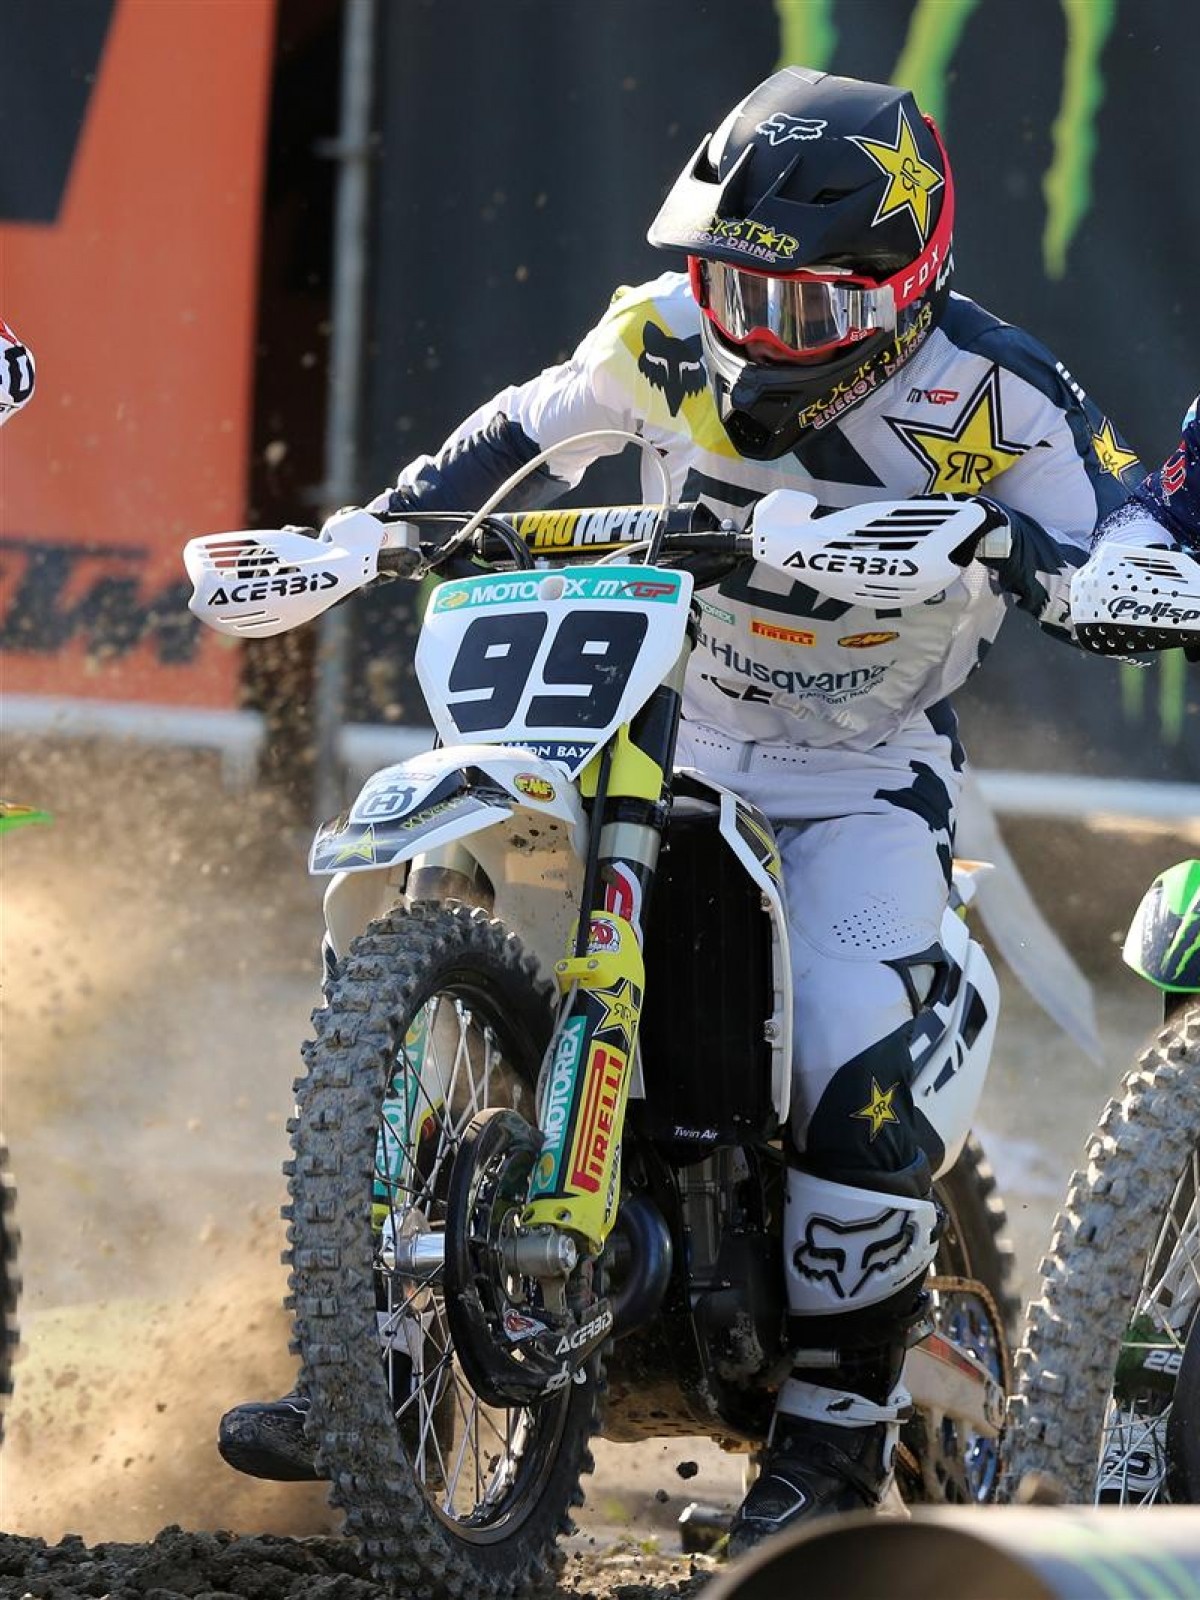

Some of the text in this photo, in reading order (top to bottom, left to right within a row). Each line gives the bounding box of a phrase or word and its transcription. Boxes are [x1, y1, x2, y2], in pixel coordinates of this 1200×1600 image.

[902, 244, 939, 299] FOX
[207, 571, 339, 606] ACERBIS
[783, 551, 919, 577] ACERBIS
[446, 610, 649, 733] 99
[711, 637, 892, 694] Husqvarna
[571, 1048, 624, 1194] PIRELLI
